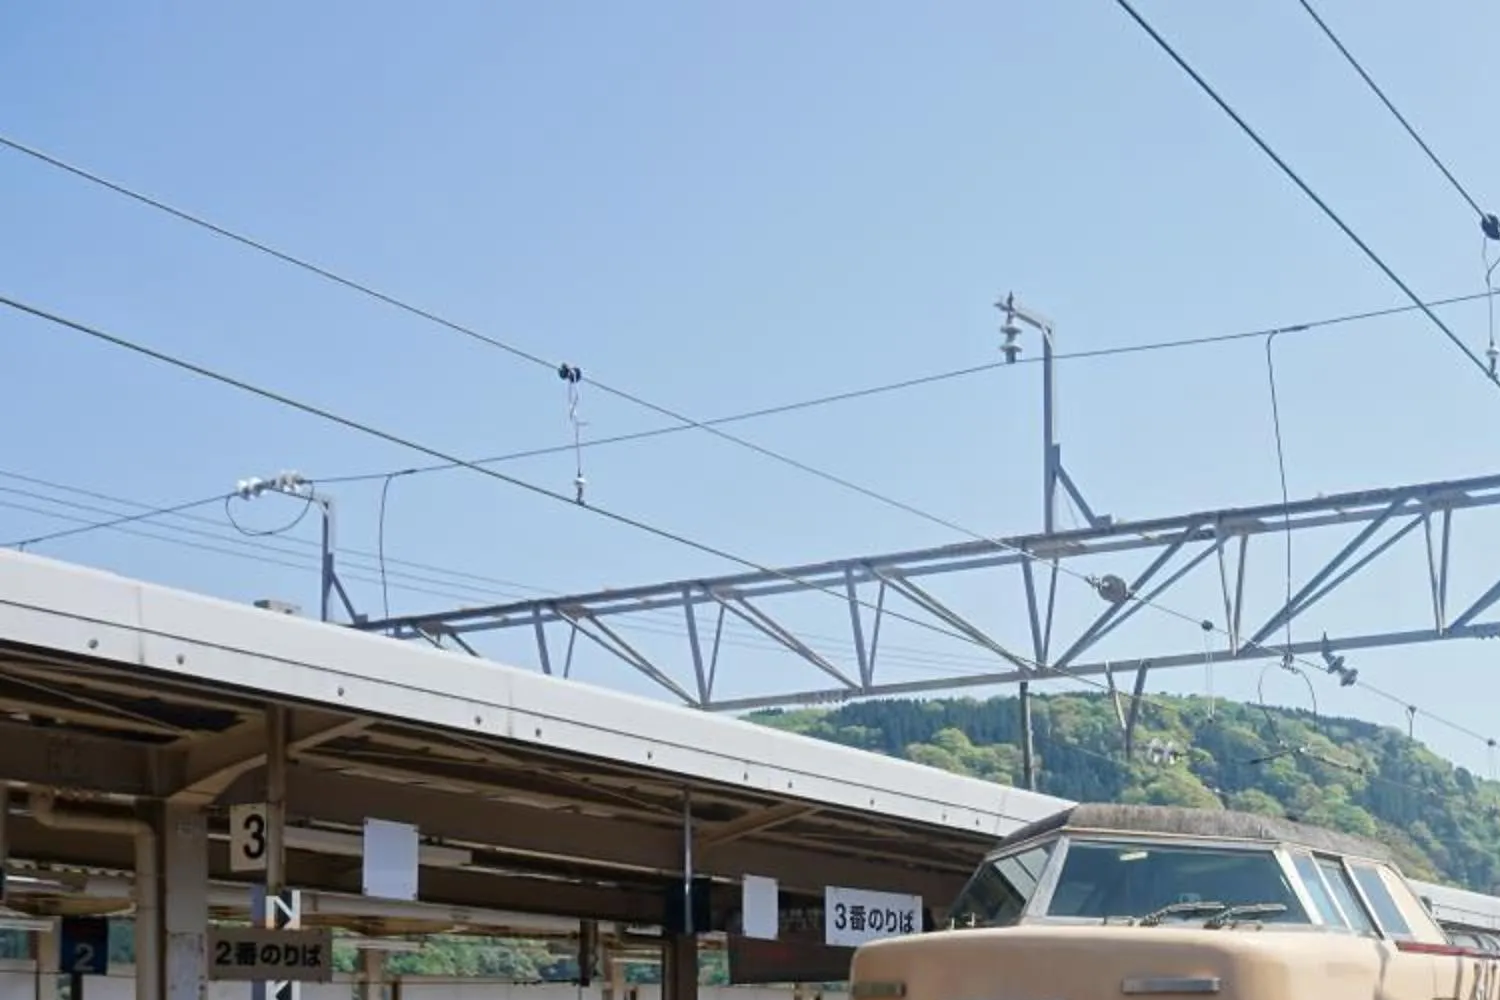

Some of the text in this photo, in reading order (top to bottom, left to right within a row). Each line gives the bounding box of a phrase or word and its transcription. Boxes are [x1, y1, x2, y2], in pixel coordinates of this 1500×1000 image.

[243, 814, 265, 859] 3
[834, 902, 915, 934] 3番のりば
[73, 943, 96, 972] 2
[215, 941, 322, 967] 2番のりば
